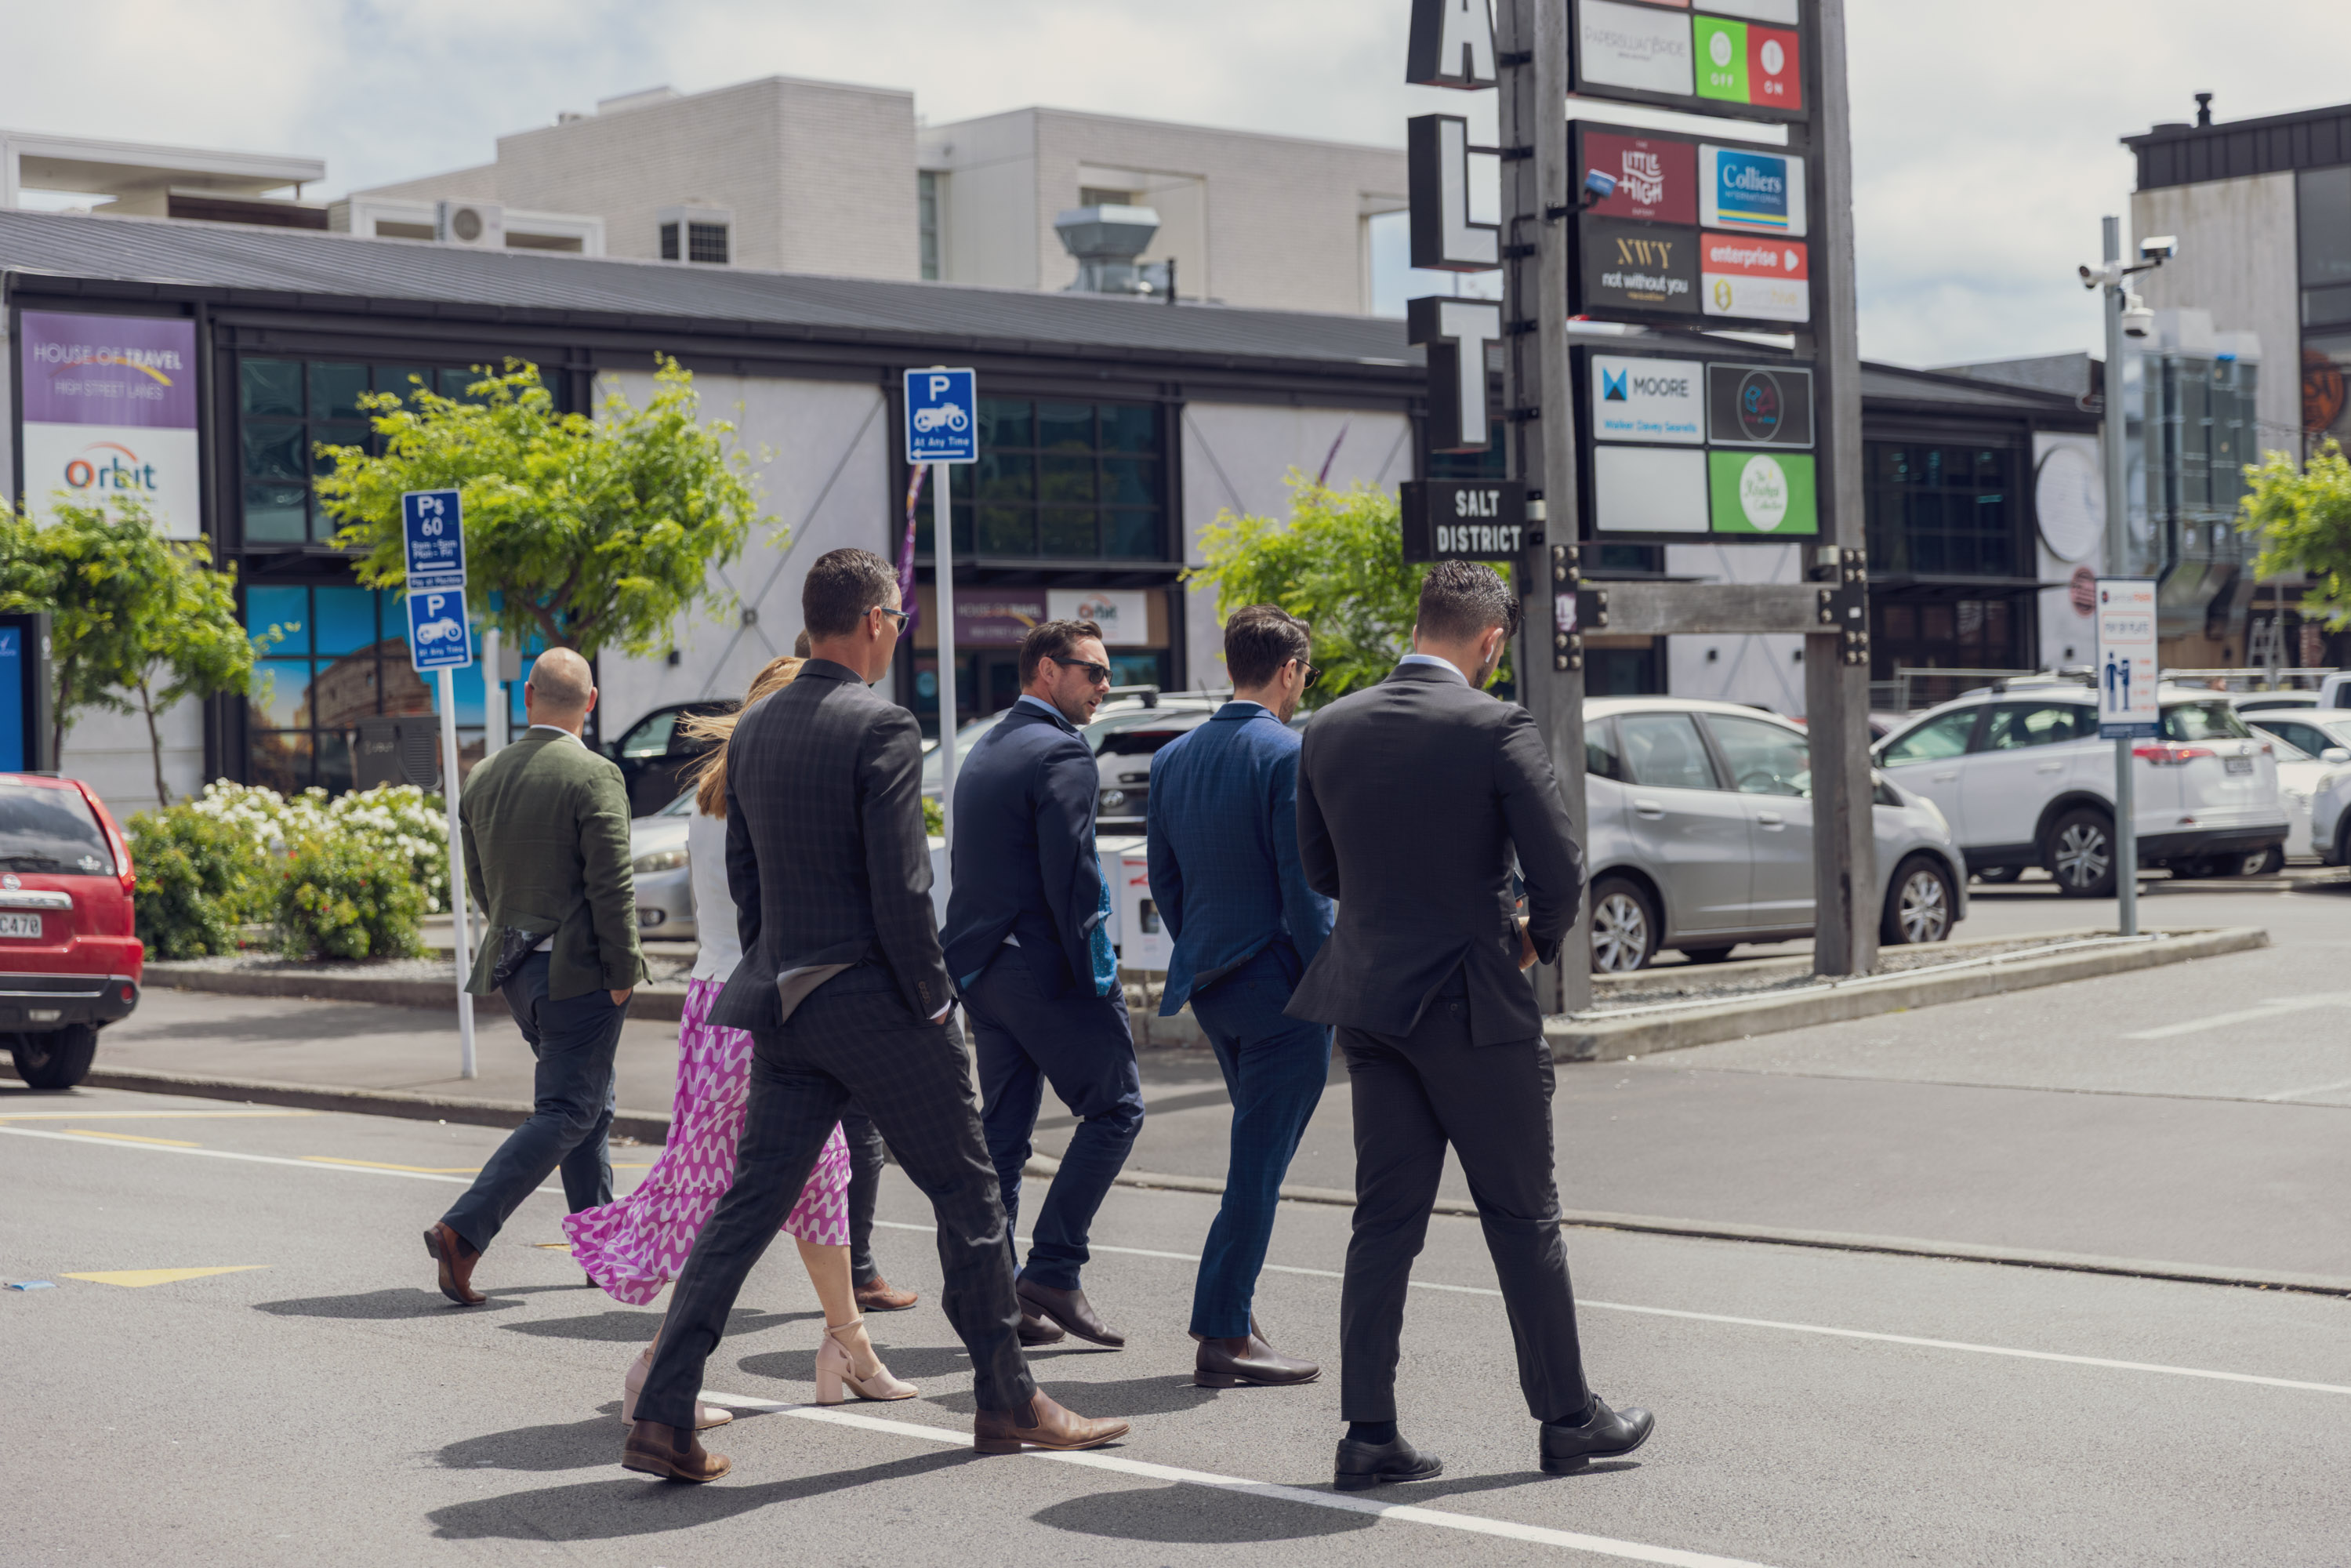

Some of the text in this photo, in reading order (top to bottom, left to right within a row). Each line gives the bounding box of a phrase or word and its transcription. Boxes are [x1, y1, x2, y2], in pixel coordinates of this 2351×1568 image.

[1710, 72, 1734, 88] OFF
[1764, 81, 1783, 95] ON
[1622, 149, 1665, 183] LITTLE
[1617, 174, 1663, 205] HIGH
[1723, 164, 1782, 194] Colliers
[1616, 238, 1672, 269] NWY
[1710, 245, 1777, 269] enterprise
[1602, 270, 1689, 296] not without you
[34, 343, 183, 370] HOUSE OF TRAVEL
[55, 379, 164, 401] HIGH STREET LANES
[929, 376, 950, 401] P
[1634, 376, 1689, 398] MOORE
[914, 436, 970, 448] At Any Time
[65, 455, 158, 491] Orbit
[1455, 489, 1500, 517] SALT
[422, 517, 443, 536] 60
[1436, 524, 1522, 553] DISTRICT
[426, 594, 445, 618] P
